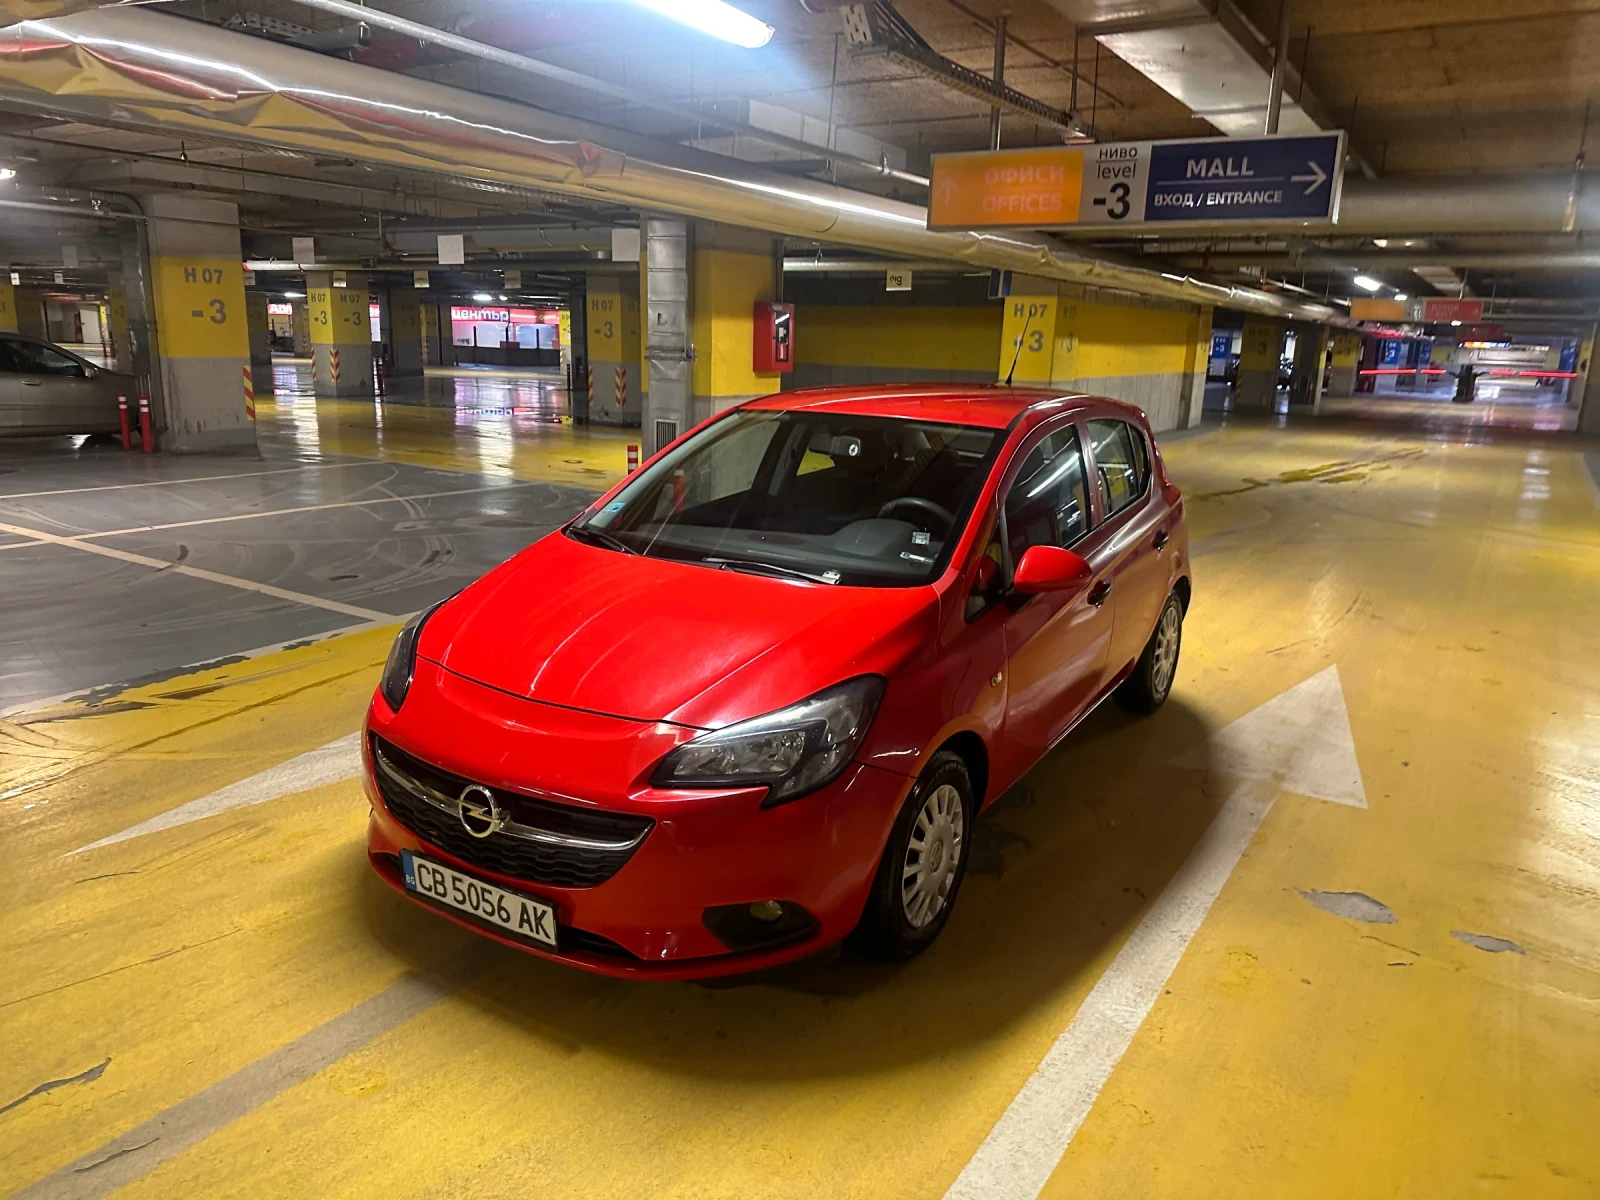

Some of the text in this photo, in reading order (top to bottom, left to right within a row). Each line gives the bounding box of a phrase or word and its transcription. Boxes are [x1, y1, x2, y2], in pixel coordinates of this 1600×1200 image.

[984, 165, 1065, 185] ОФИСИ
[1097, 162, 1137, 179] level
[1186, 156, 1254, 178] MALL
[982, 193, 1063, 213] OFFICES
[1092, 182, 1131, 220] -3
[1153, 192, 1194, 208] ВХОД
[1206, 190, 1283, 206] ENTRANCE
[184, 267, 224, 285] H 07
[318, 293, 326, 303] 07
[340, 294, 360, 304] H 07
[592, 299, 614, 312] H 07
[191, 298, 227, 325] -3
[1013, 303, 1048, 318] H 07
[405, 874, 416, 885] BG
[417, 863, 551, 940] CB 5056 AK
